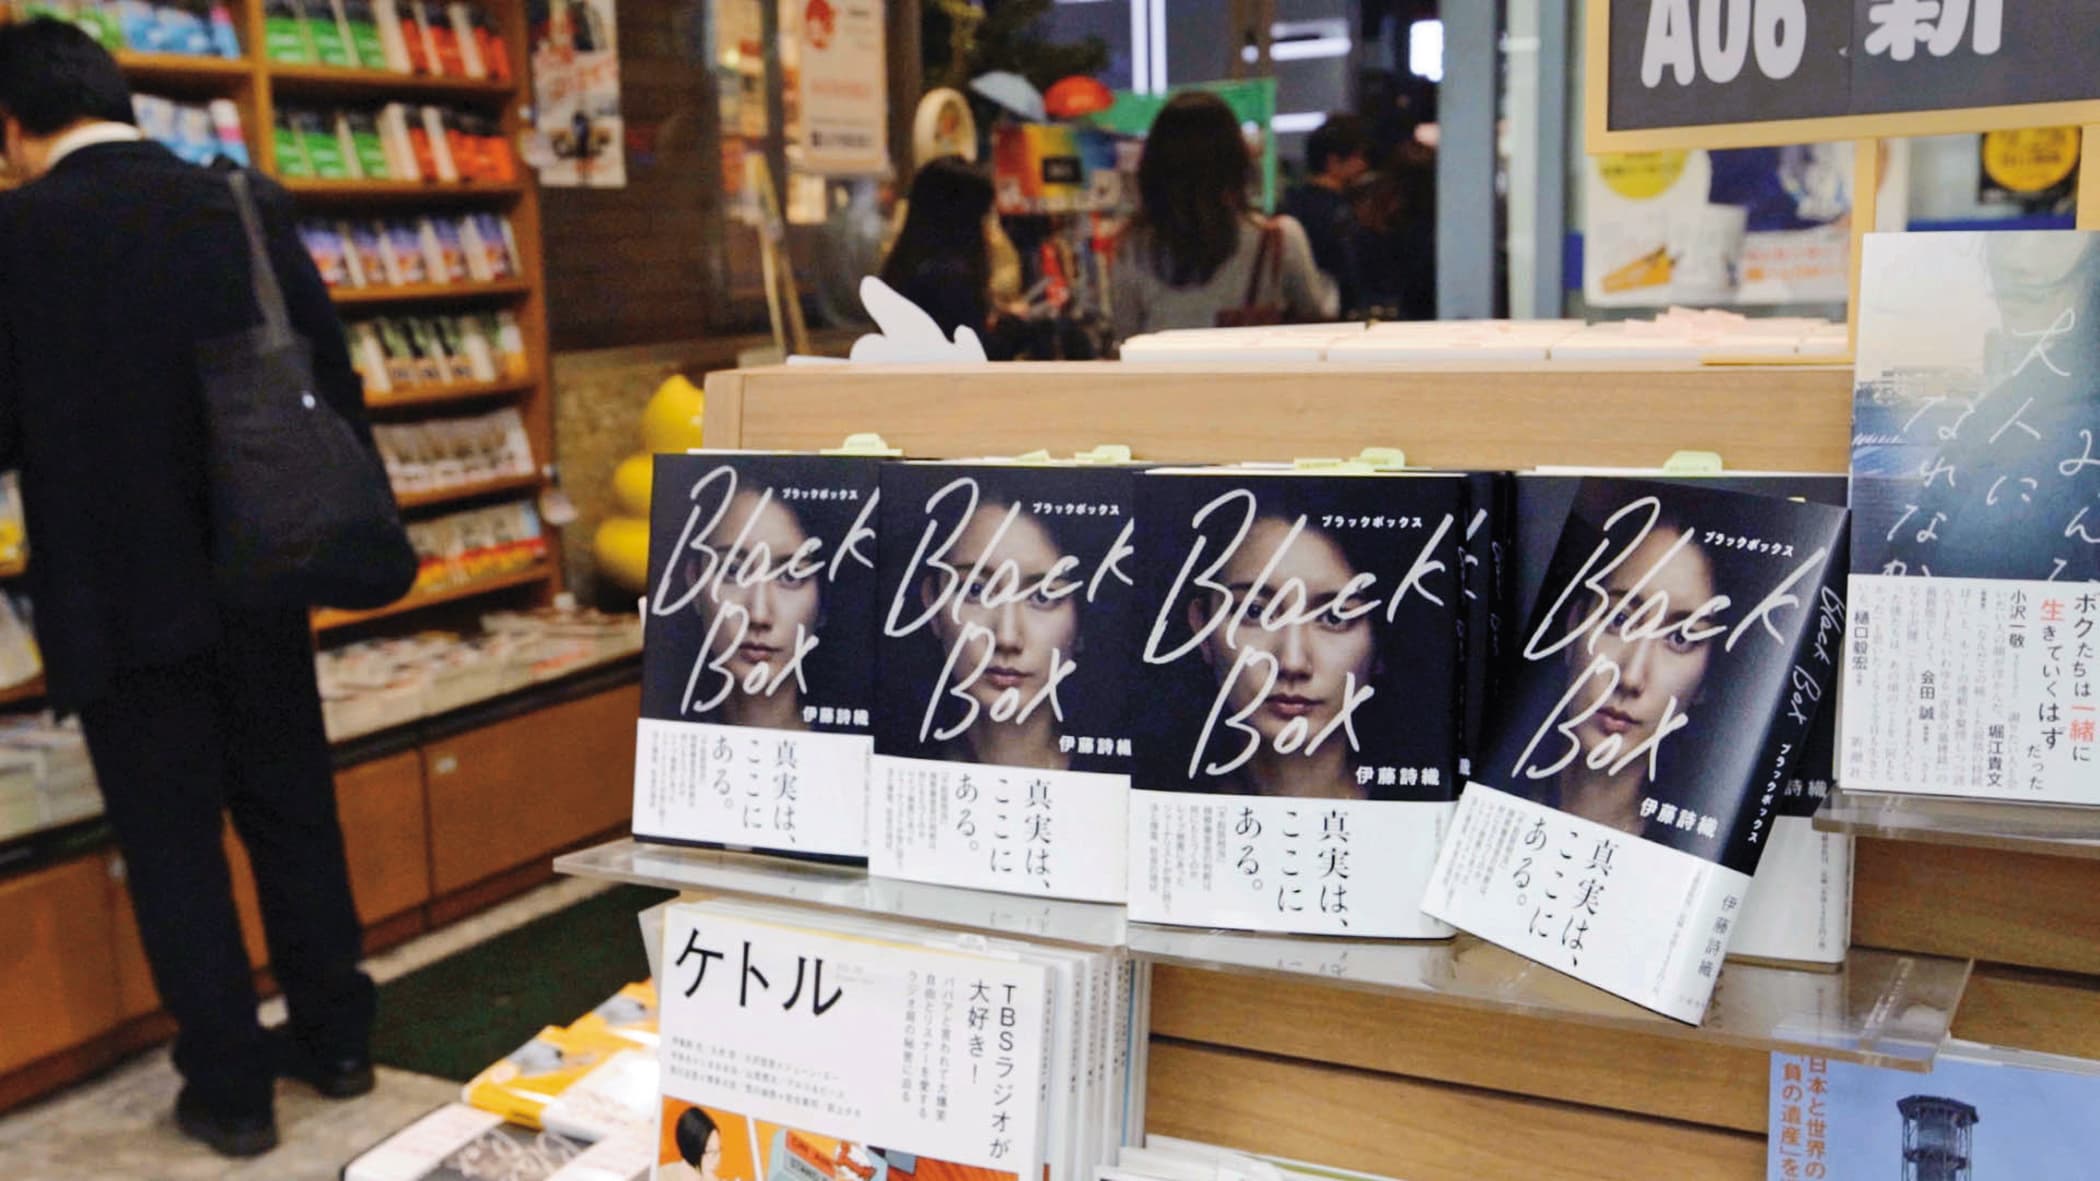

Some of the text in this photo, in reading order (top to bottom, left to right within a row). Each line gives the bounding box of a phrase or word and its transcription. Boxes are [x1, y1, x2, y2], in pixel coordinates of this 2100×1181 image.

[652, 465, 879, 616] Black
[782, 488, 858, 500] ブラックボックス
[1032, 502, 1119, 516] ブラックボックス
[1321, 515, 1423, 529] ブラックボックス
[1704, 530, 1794, 558] ブラックボックス
[2048, 430, 2100, 581] みん
[884, 477, 1134, 636] Black
[1143, 488, 1454, 664] Black
[1522, 496, 1826, 660] Black
[681, 602, 819, 716] Box
[1786, 585, 1846, 726] Black Box
[2008, 589, 2027, 649] 小沢一敬
[803, 706, 869, 726] 伊藤詩織
[919, 620, 1076, 743] Box
[1189, 646, 1375, 780] Box
[1511, 653, 1689, 782] Box
[2038, 599, 2065, 749] 生きていくはず
[2070, 592, 2097, 763] ボクたちは一緒に
[712, 736, 734, 809] ある。
[744, 739, 762, 828] ここに
[773, 740, 797, 843] 真実は、
[1059, 735, 1132, 756] 伊藤詩織
[1355, 766, 1441, 786] 伊藤詩織
[1747, 744, 1791, 843] ブラックボックス
[1987, 724, 2004, 788] 堀江貴文
[2027, 744, 2044, 791] だった
[956, 773, 979, 850] ある。
[990, 778, 1012, 872] ここに
[1025, 779, 1051, 888] 真実は、
[1236, 807, 1263, 891] ある。
[1278, 811, 1303, 912] ここに
[1512, 816, 1548, 907] ある。
[1639, 797, 1719, 839] 伊藤詩織
[1317, 810, 1349, 927] 真実は、
[1529, 831, 1579, 939] ここに
[1561, 839, 1619, 968] 真実は、
[674, 927, 844, 1018] ケトル
[990, 983, 1018, 1159] TBSラジオが
[1804, 1056, 1828, 1180] 日本と世界の
